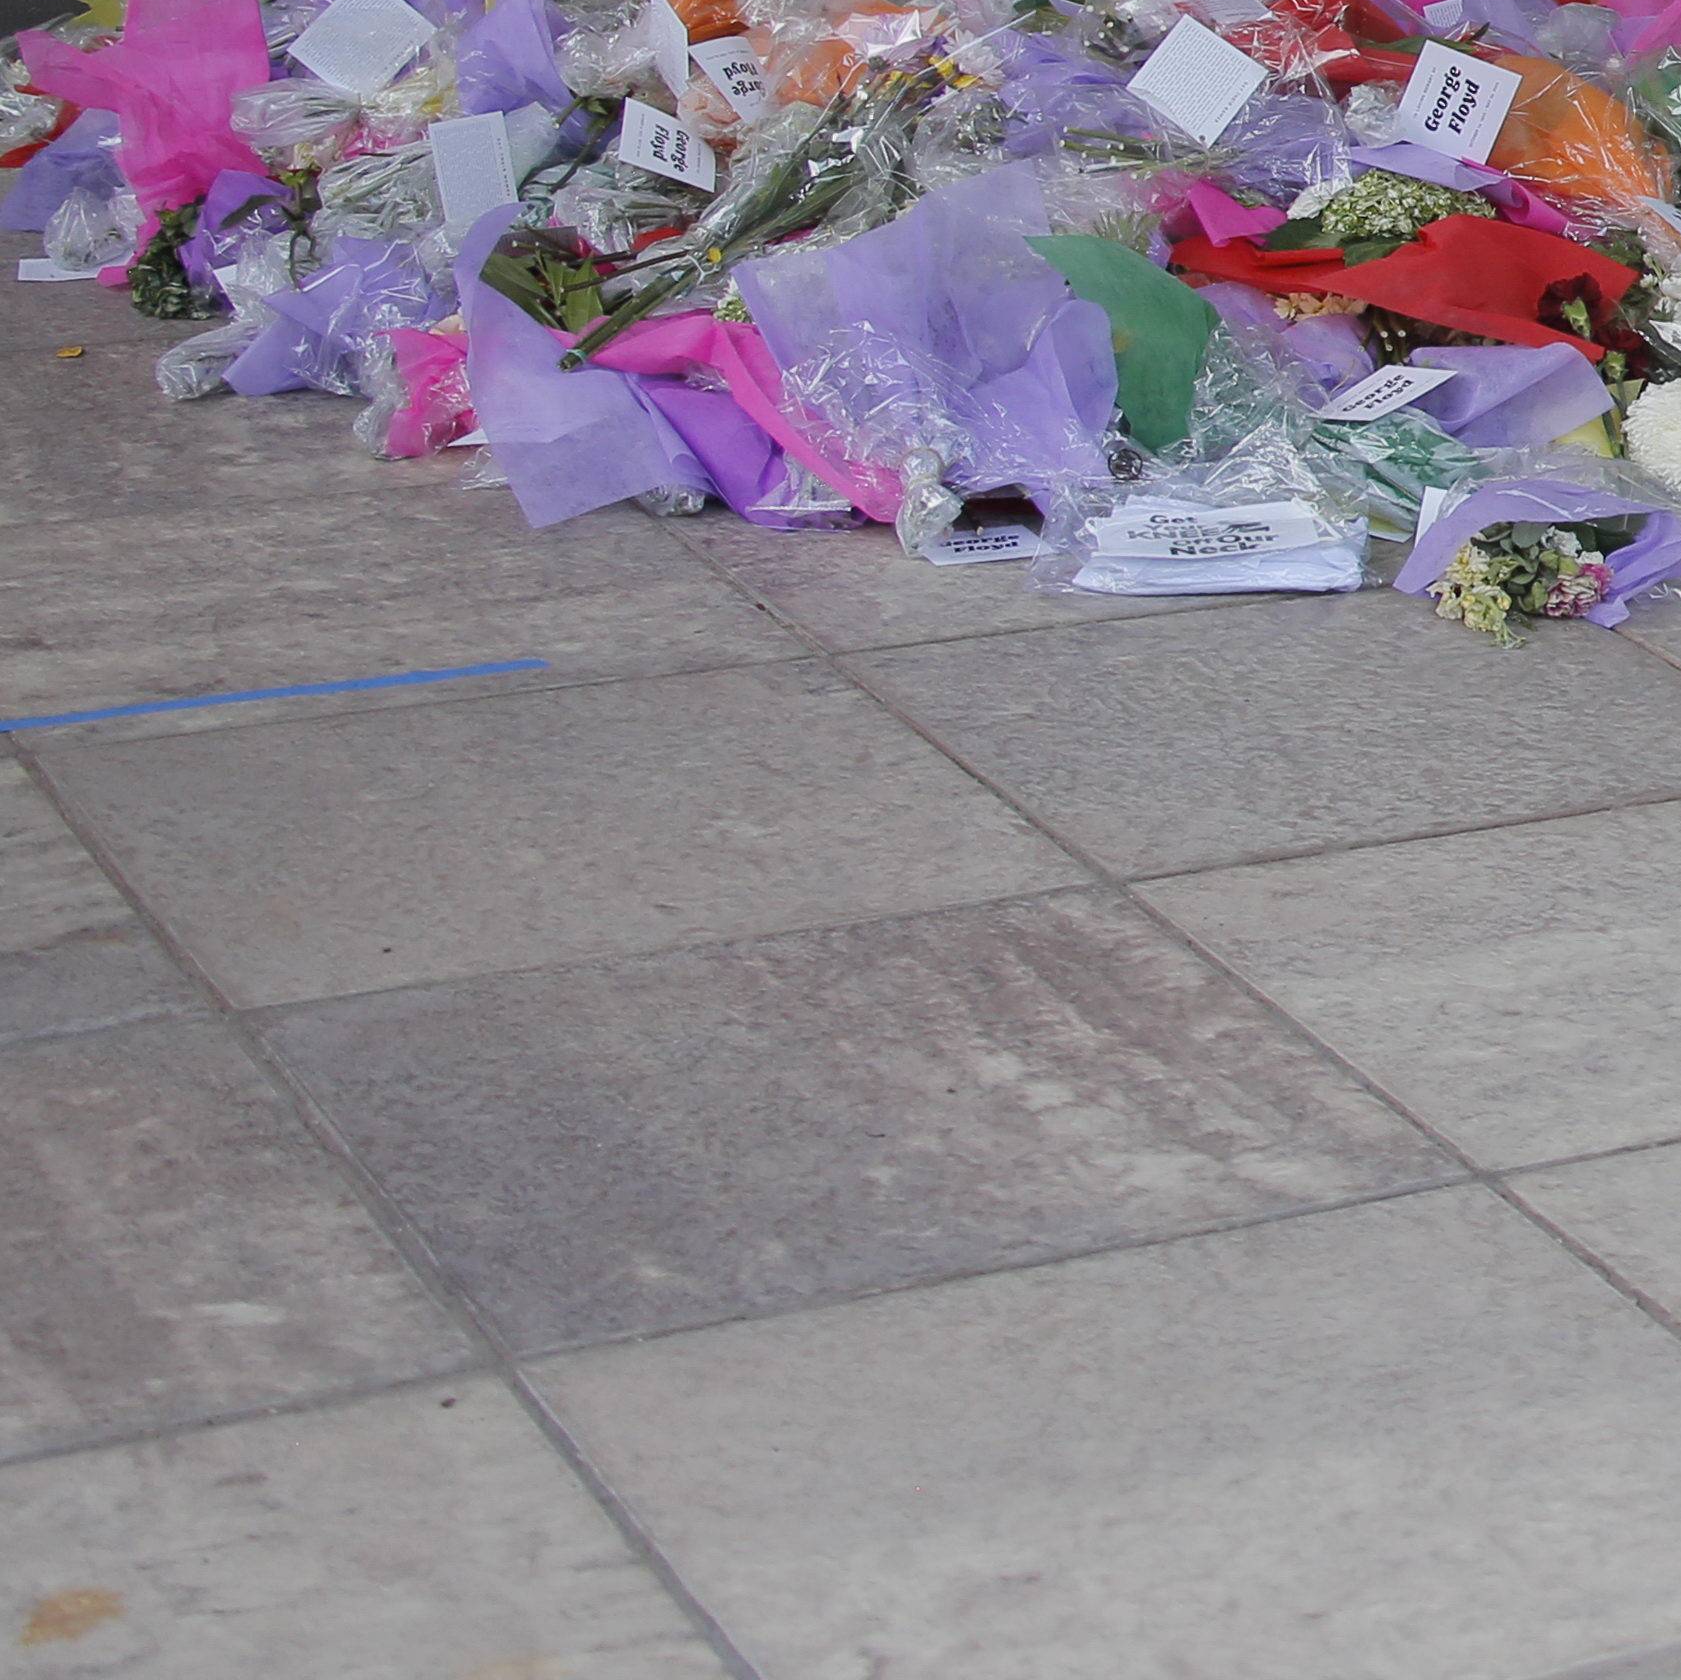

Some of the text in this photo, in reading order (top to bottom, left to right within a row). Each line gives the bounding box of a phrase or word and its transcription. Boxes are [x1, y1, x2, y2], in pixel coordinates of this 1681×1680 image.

[731, 80, 766, 97] orge
[1424, 65, 1461, 131] George
[1448, 78, 1480, 135] Floyd
[650, 124, 670, 162] Floyd
[671, 130, 690, 173] George
[1342, 374, 1404, 412] George
[1364, 379, 1414, 409] Floyd
[1127, 526, 1220, 540] KNEE
[1149, 514, 1198, 524] Get
[1169, 541, 1260, 556] Neck
[1216, 533, 1279, 544] Our
